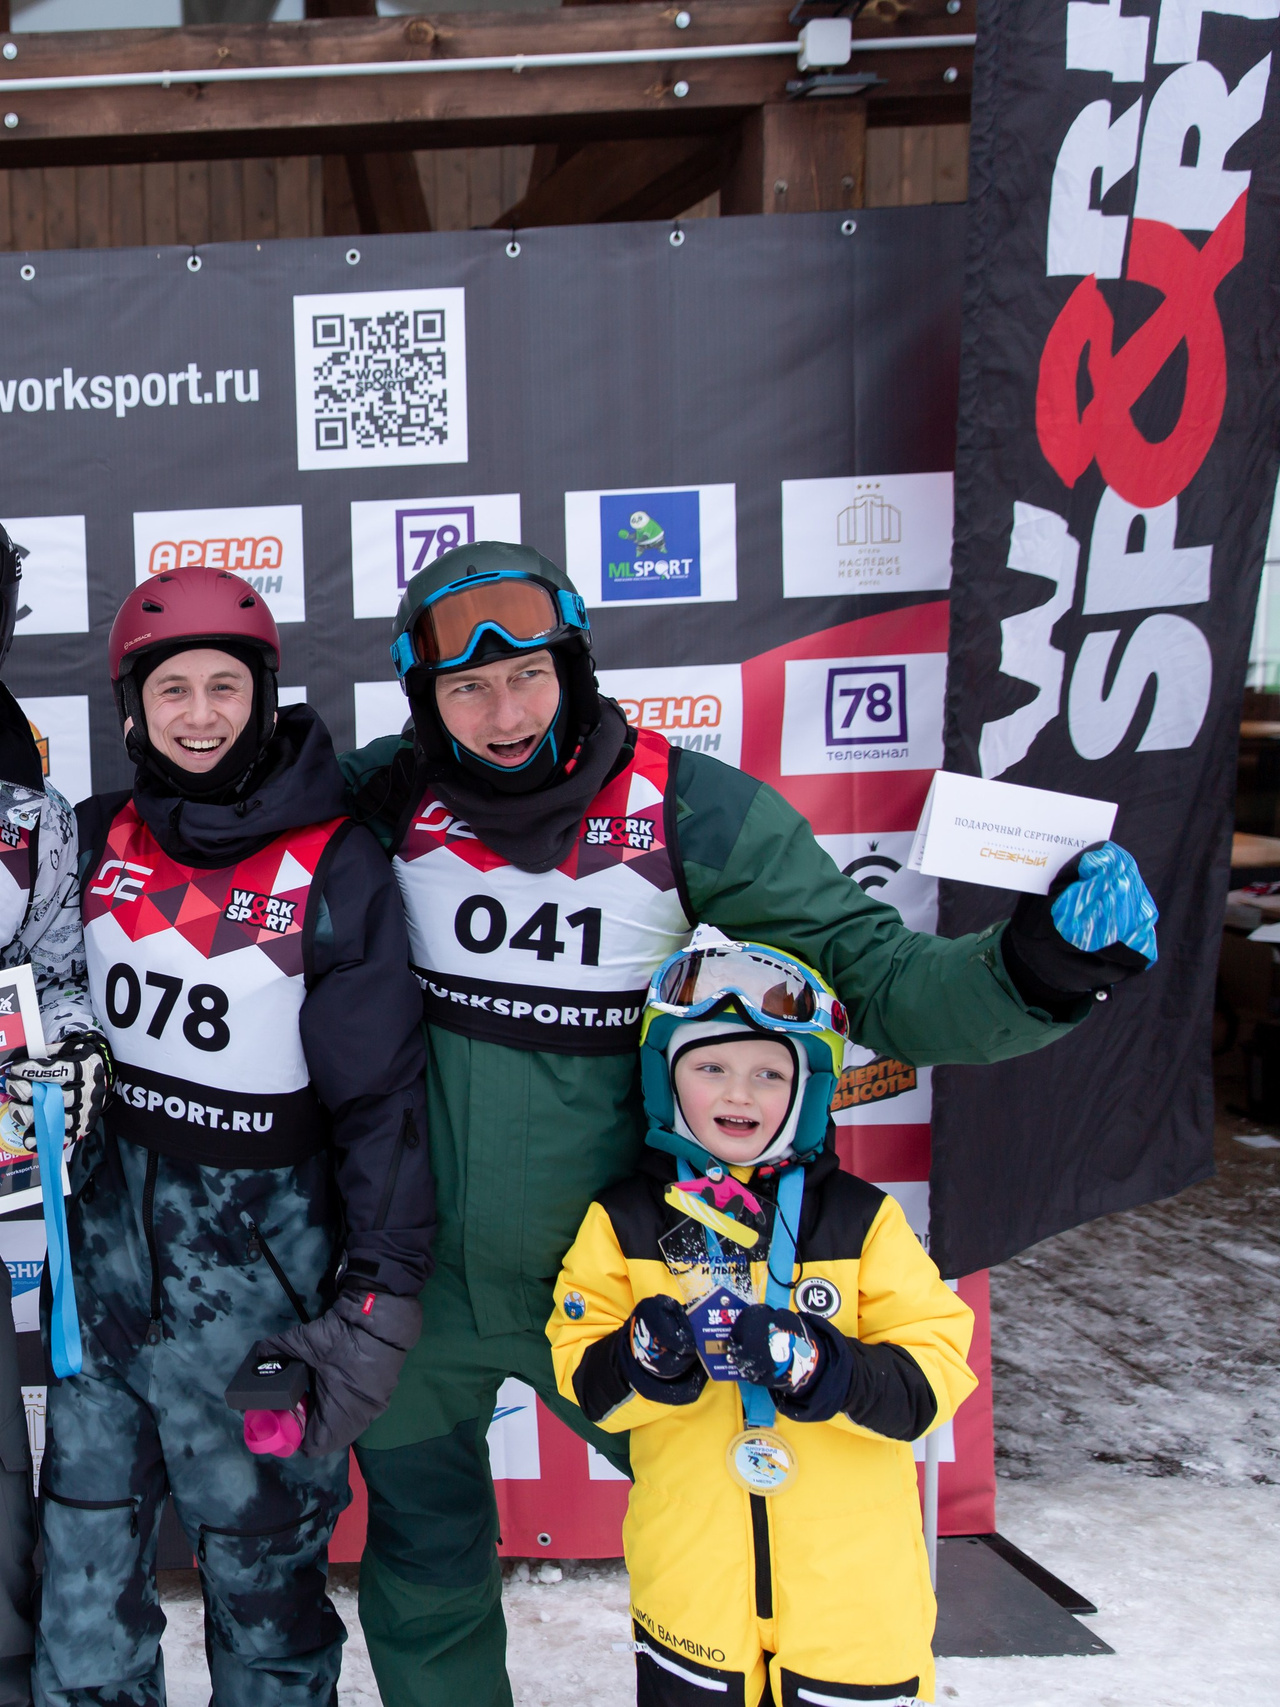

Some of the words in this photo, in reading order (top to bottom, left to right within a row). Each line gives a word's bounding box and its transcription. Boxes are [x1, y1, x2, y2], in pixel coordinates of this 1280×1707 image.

[149, 536, 283, 574] АРЕНА
[838, 566, 902, 578] HERITAGE
[839, 556, 901, 568] НАСЛЕДИЕ
[621, 695, 722, 731] РЕНА
[839, 683, 893, 729] 78
[826, 747, 909, 762] телеканал
[954, 816, 1022, 837] ПОДАРОЧНЫЙ
[1023, 829, 1088, 849] СЕРТИФИКАТ
[979, 847, 1049, 868] СНЕЖНЫЙ
[454, 894, 602, 967] 041
[105, 962, 231, 1052] 078
[21, 1065, 69, 1079] reusch
[830, 1070, 916, 1111] ВЫСОТЫ
[632, 1604, 655, 1634] NIKKI
[658, 1625, 726, 1663] BAMBINO
